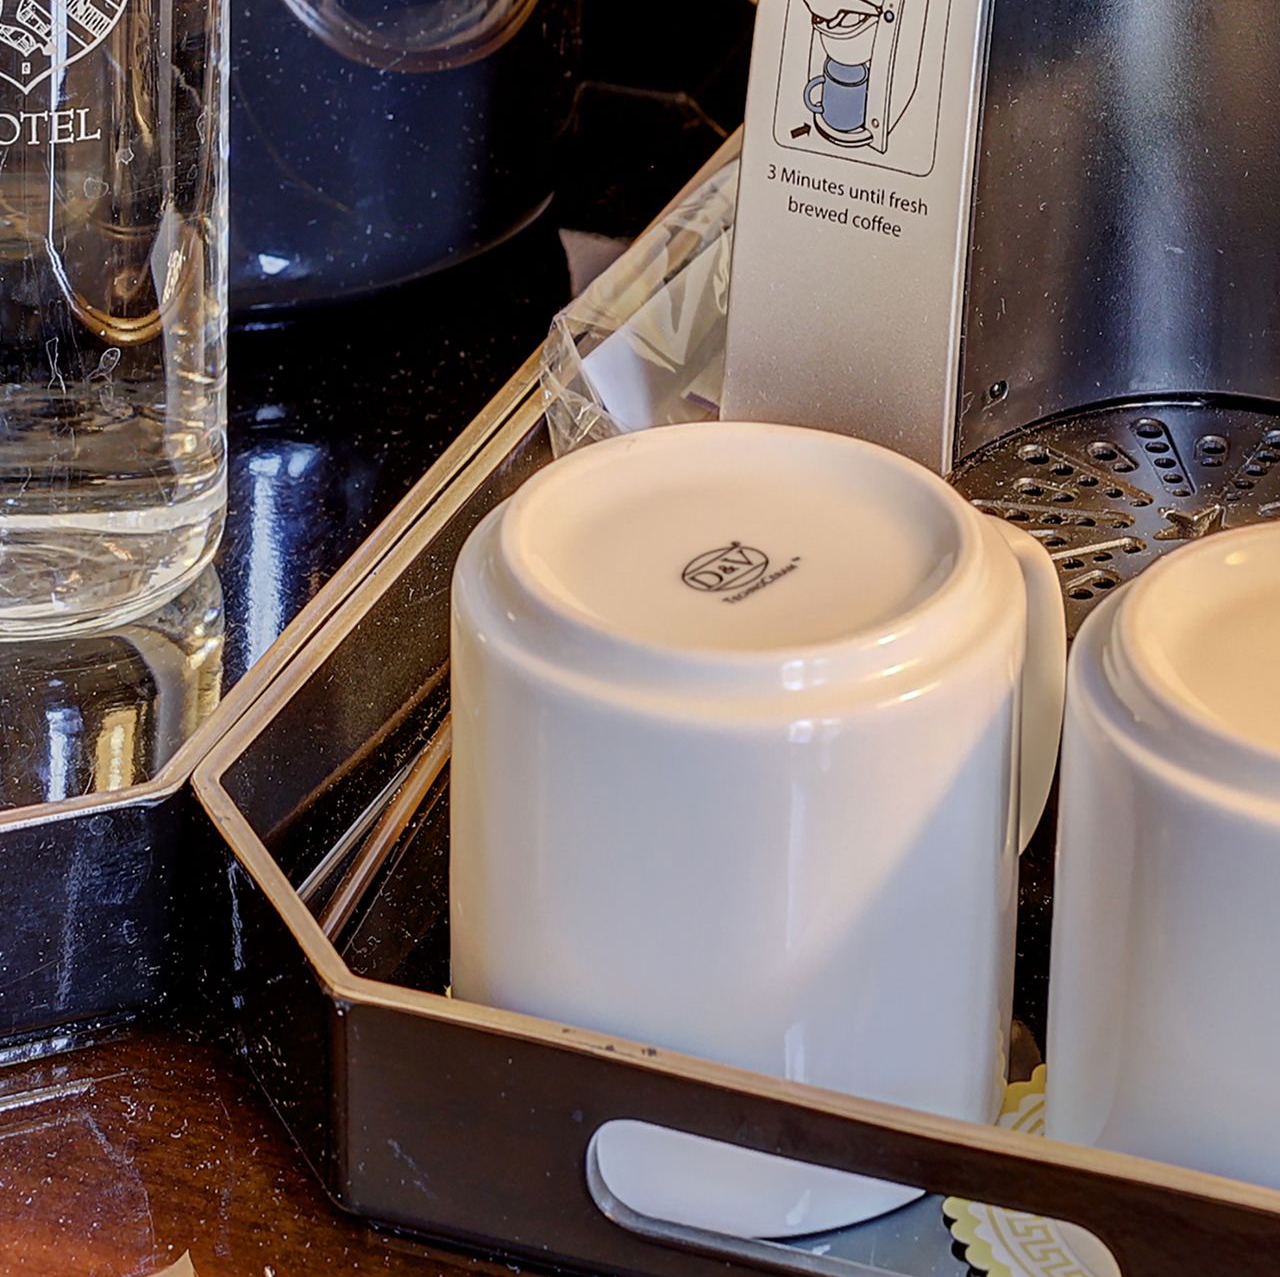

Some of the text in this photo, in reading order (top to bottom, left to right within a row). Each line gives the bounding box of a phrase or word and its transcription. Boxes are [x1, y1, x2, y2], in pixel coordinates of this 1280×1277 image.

[767, 164, 928, 216] 3 Minutes until fresh
[788, 196, 902, 238] brewed coffee
